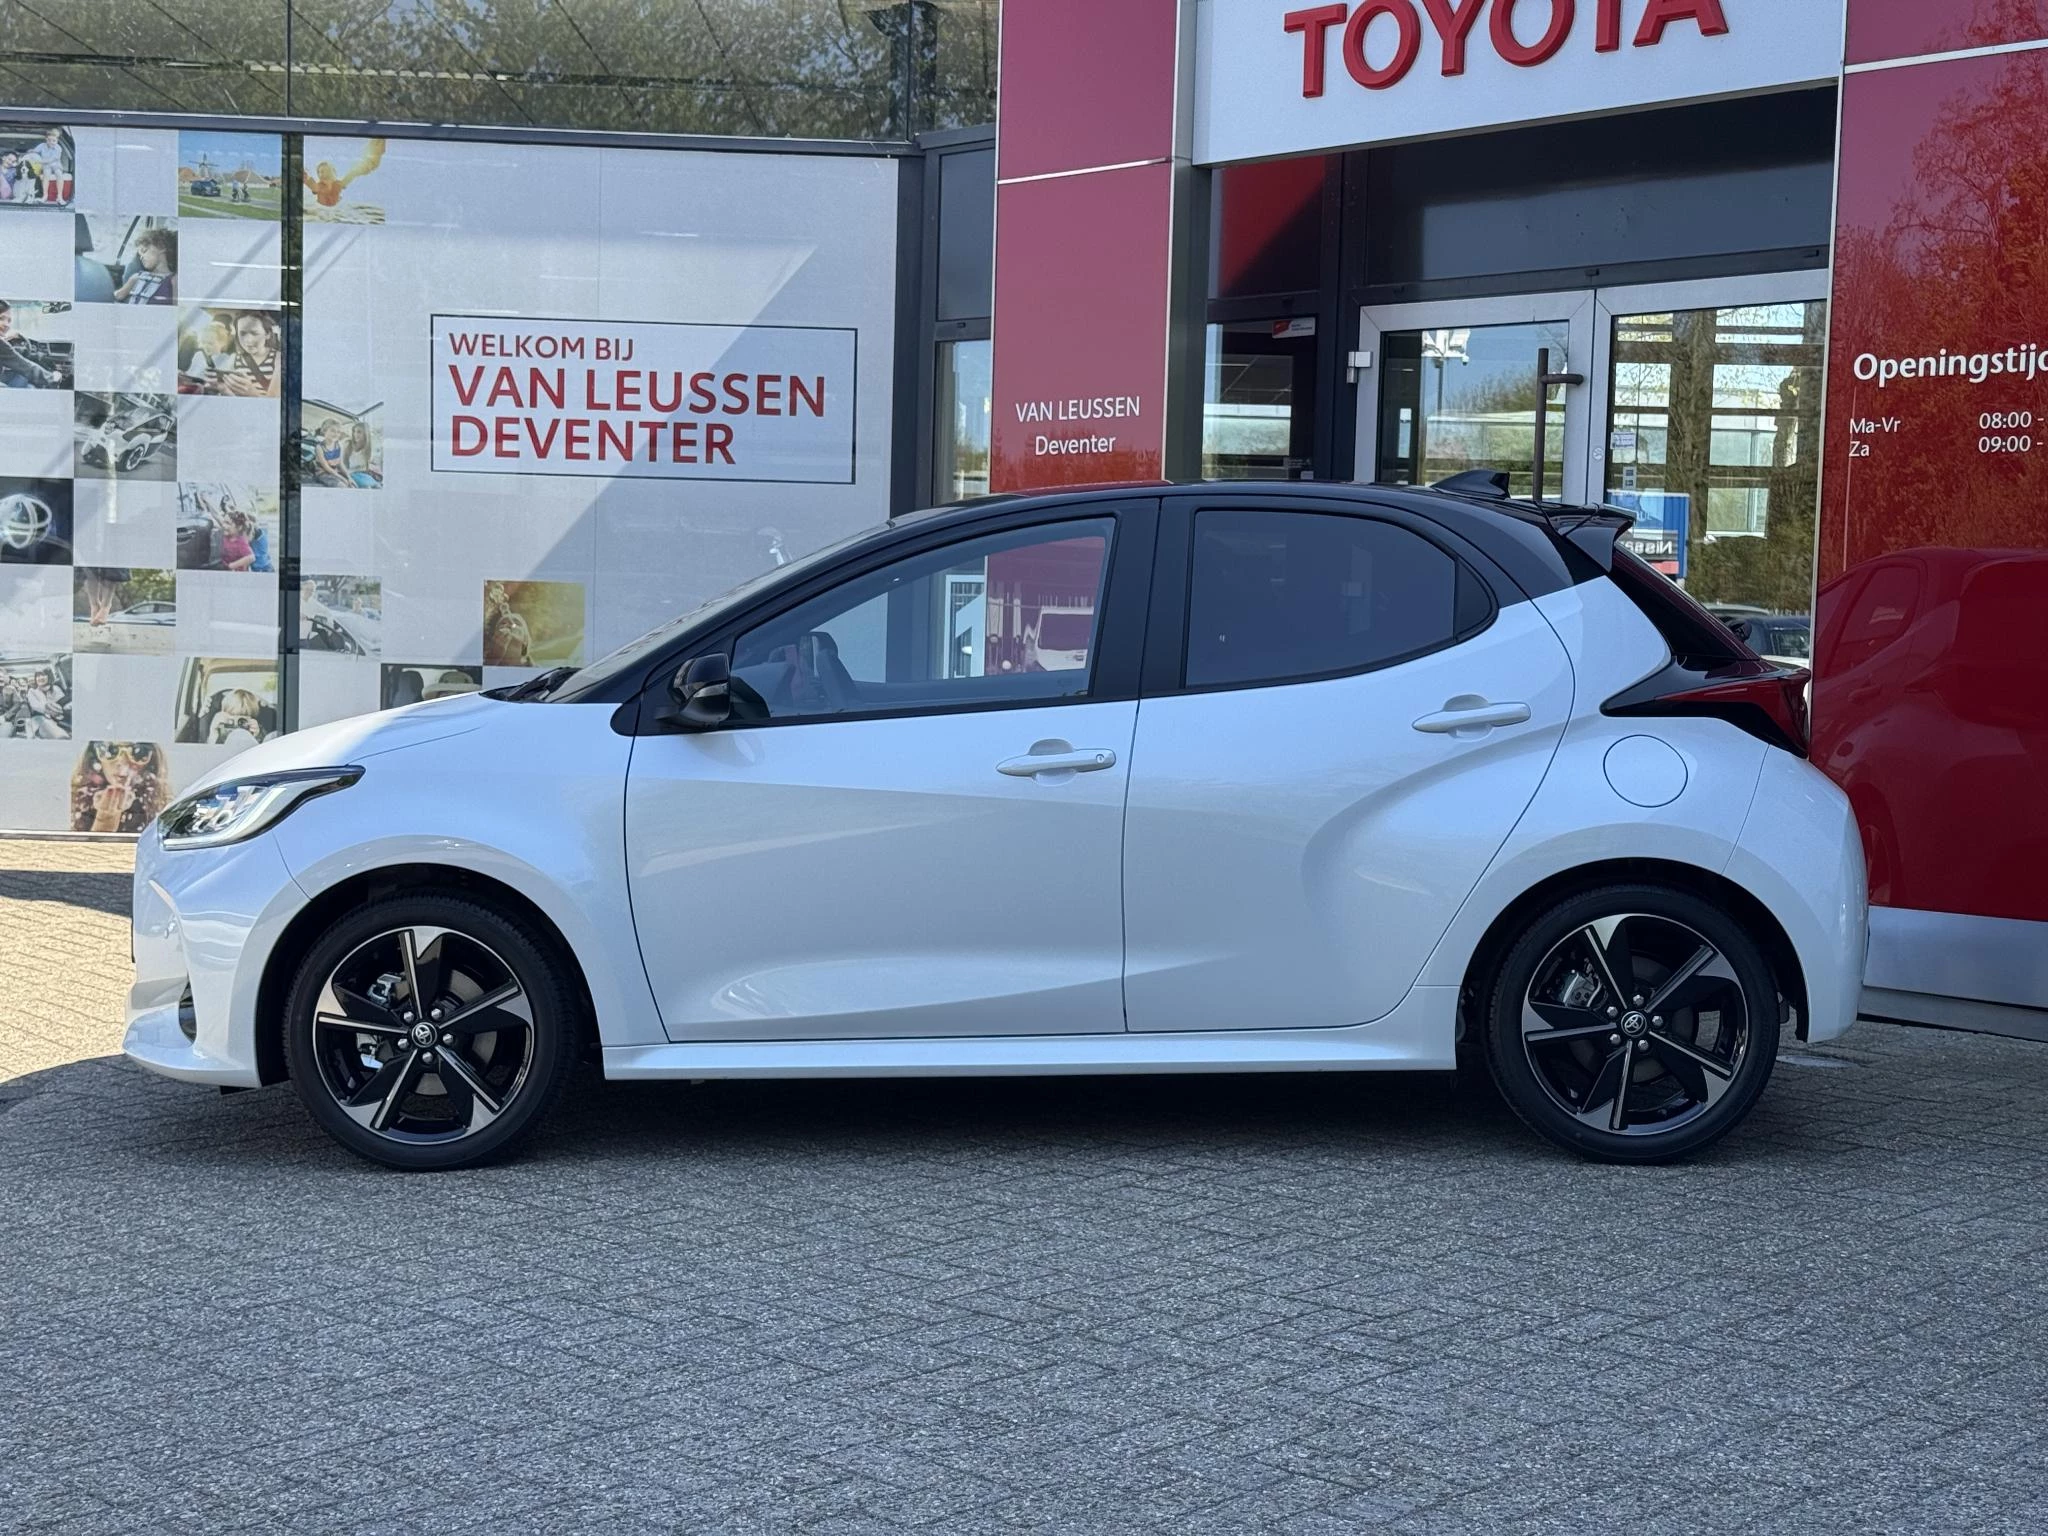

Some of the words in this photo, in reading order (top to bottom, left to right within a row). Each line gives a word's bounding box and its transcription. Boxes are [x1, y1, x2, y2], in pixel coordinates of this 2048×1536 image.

[449, 333, 585, 359] WELKOM
[595, 338, 634, 361] BIJ
[448, 365, 565, 409] VAN
[586, 369, 825, 417] LEUSSEN
[1015, 401, 1053, 422] VAN
[1058, 396, 1140, 420] LEUSSEN
[1850, 417, 1901, 434] Ma-Vr
[1979, 411, 2032, 429] 08:00
[452, 415, 736, 464] DEVENTER
[1035, 434, 1116, 456] Deventer
[1849, 441, 1870, 457] Za
[1978, 435, 2032, 453] 09:00
